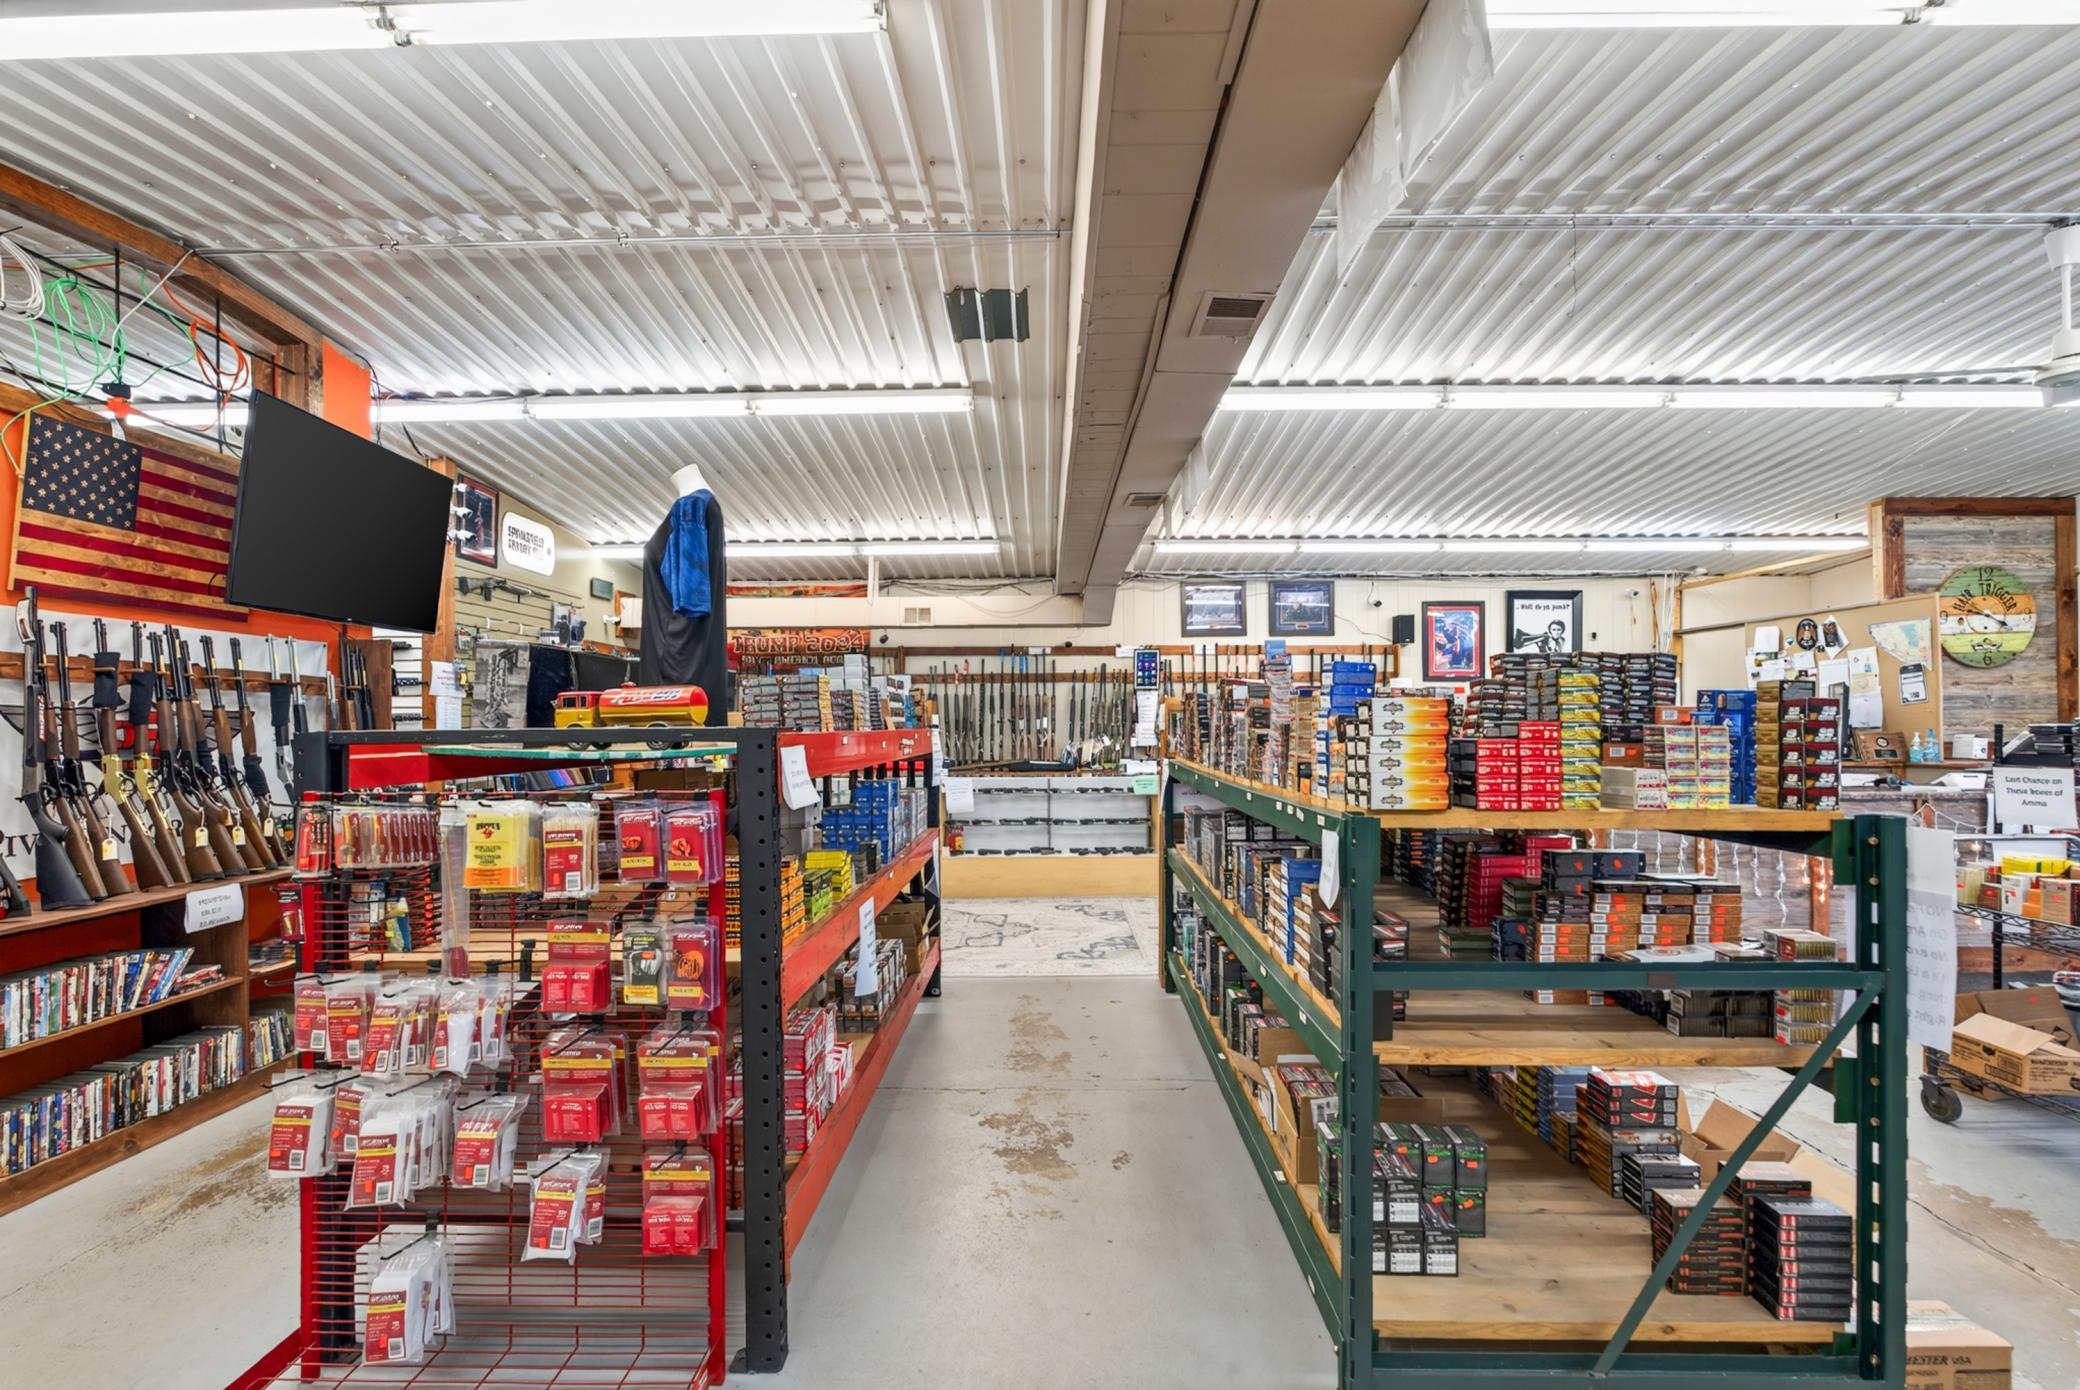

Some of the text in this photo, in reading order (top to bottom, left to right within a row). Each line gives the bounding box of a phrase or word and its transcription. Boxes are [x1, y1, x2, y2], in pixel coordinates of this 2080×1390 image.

[1978, 566, 1995, 581] 12
[1953, 582, 2017, 612] HAIR TRIGGER
[732, 635, 800, 653] TRUMP
[2022, 776, 2050, 785] Chance
[2021, 799, 2047, 807] Ammo
